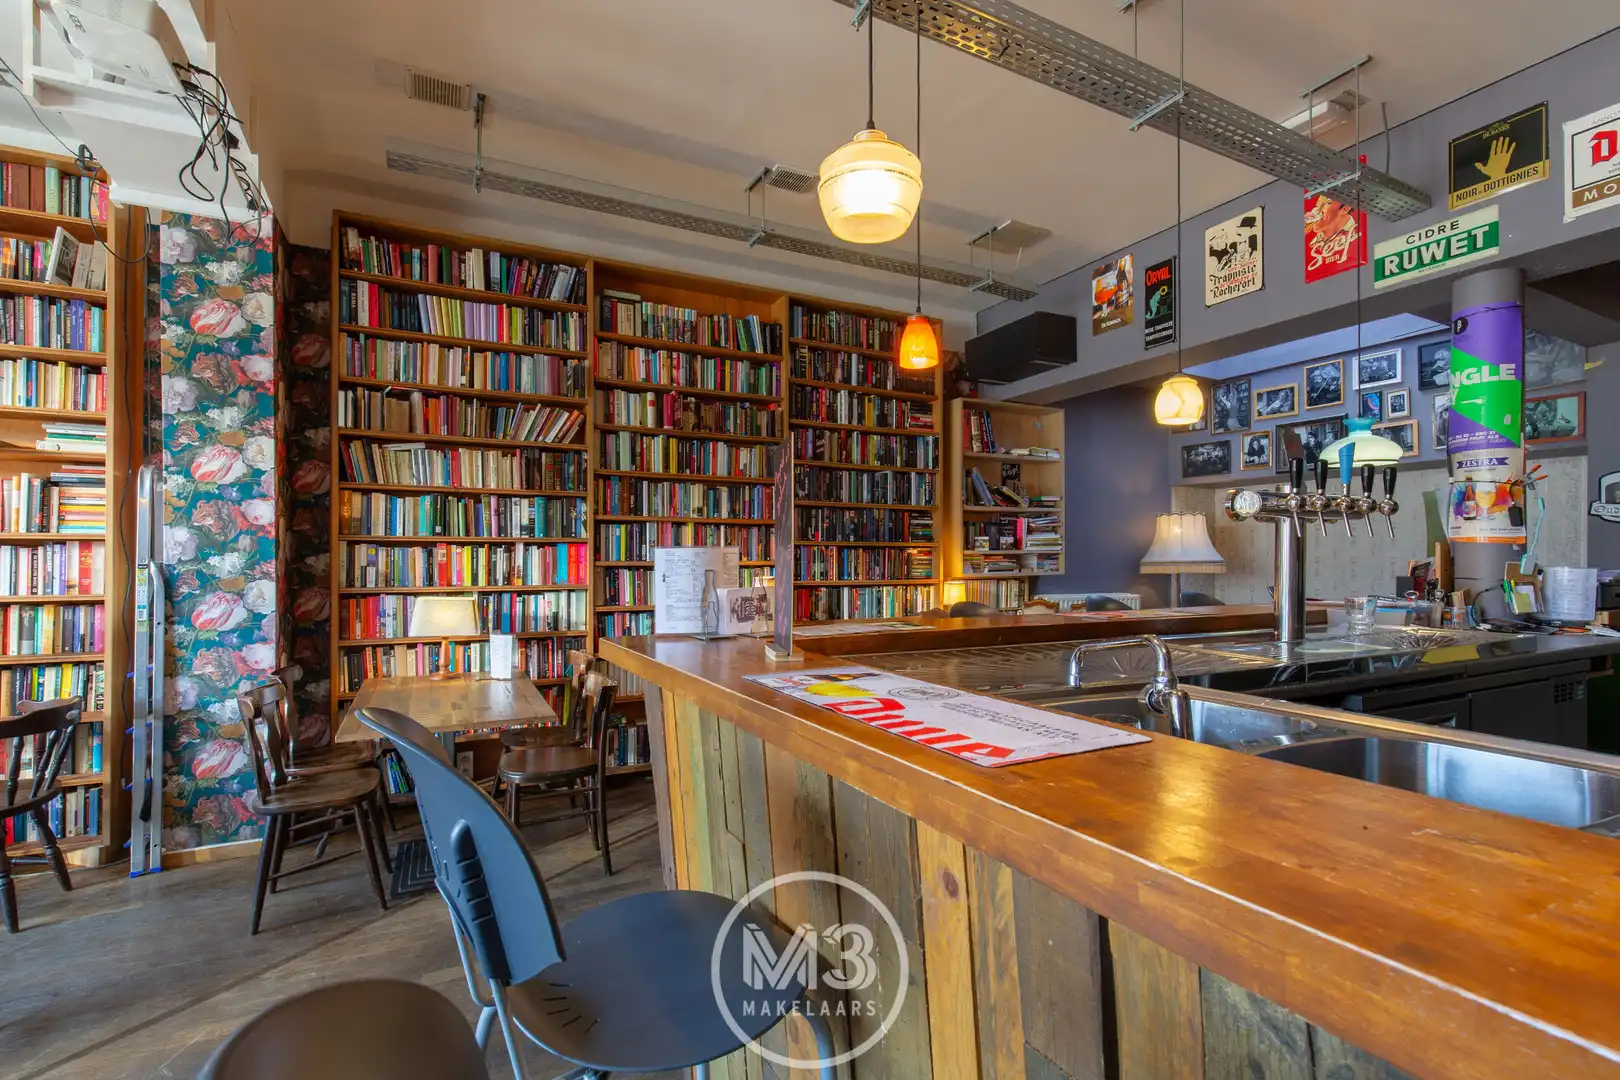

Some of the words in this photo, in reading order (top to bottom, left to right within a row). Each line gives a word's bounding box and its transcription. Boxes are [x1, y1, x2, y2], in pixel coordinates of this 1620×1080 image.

[1455, 187, 1478, 202] NOIR
[1483, 166, 1539, 193] DOTTIGNIES
[1405, 220, 1459, 244] CIDRE
[1325, 254, 1340, 264] BIER
[1384, 226, 1490, 276] RUWET
[1210, 277, 1256, 299] Rochefort
[1461, 457, 1499, 468] ZESTRA
